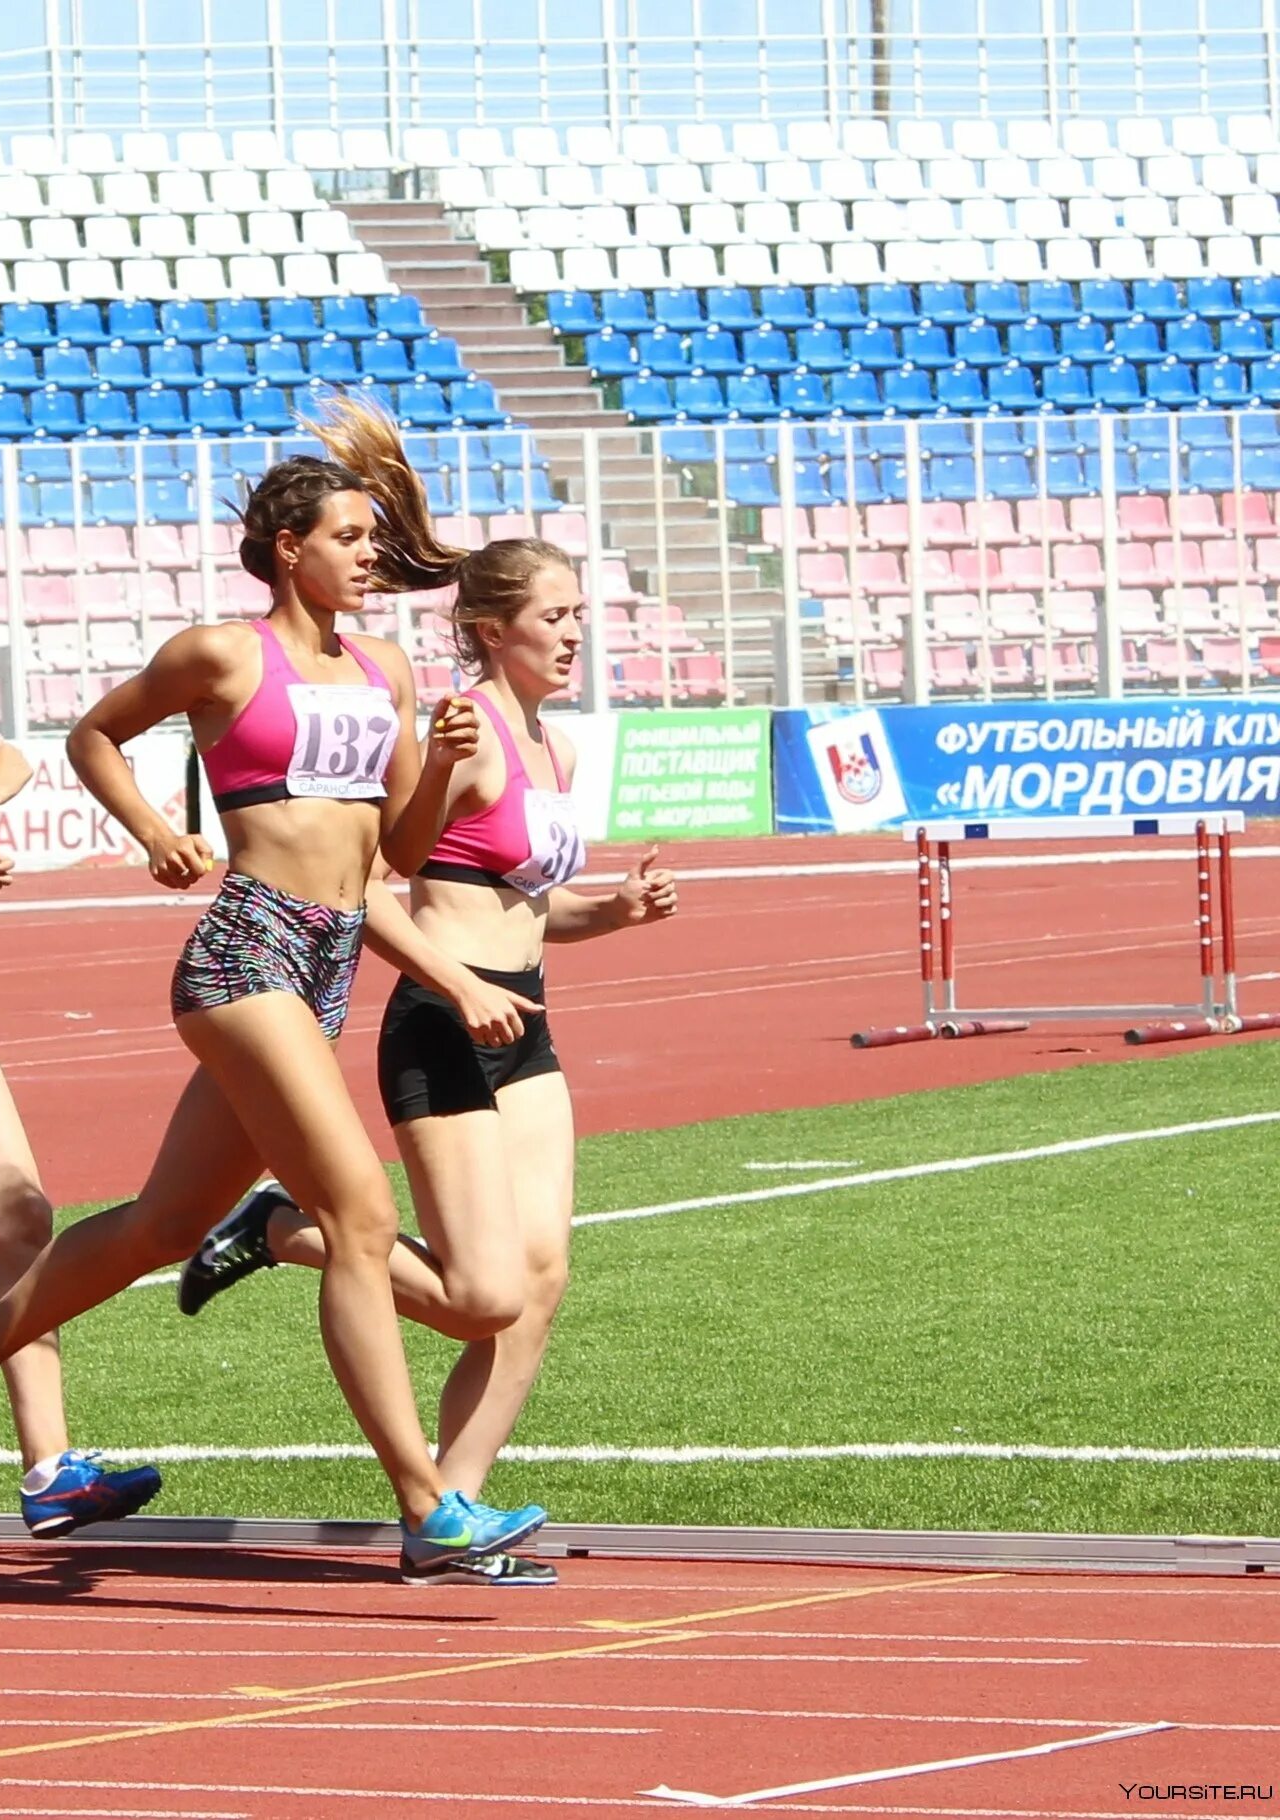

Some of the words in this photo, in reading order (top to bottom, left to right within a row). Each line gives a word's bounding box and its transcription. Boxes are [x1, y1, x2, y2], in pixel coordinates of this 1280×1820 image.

[624, 720, 760, 749] ОФИЦИАЛЬНЫЙ
[936, 708, 1206, 755] ФУТБОЛЬНЫЙ
[296, 713, 392, 783] 137
[621, 748, 759, 777] ПОСТАВЩИК
[618, 779, 703, 803] ПИТЬЕВОЙ
[705, 780, 756, 801] ВОДЫ
[937, 756, 1280, 816] «МОРДОВИЯ
[616, 809, 643, 828] ФК
